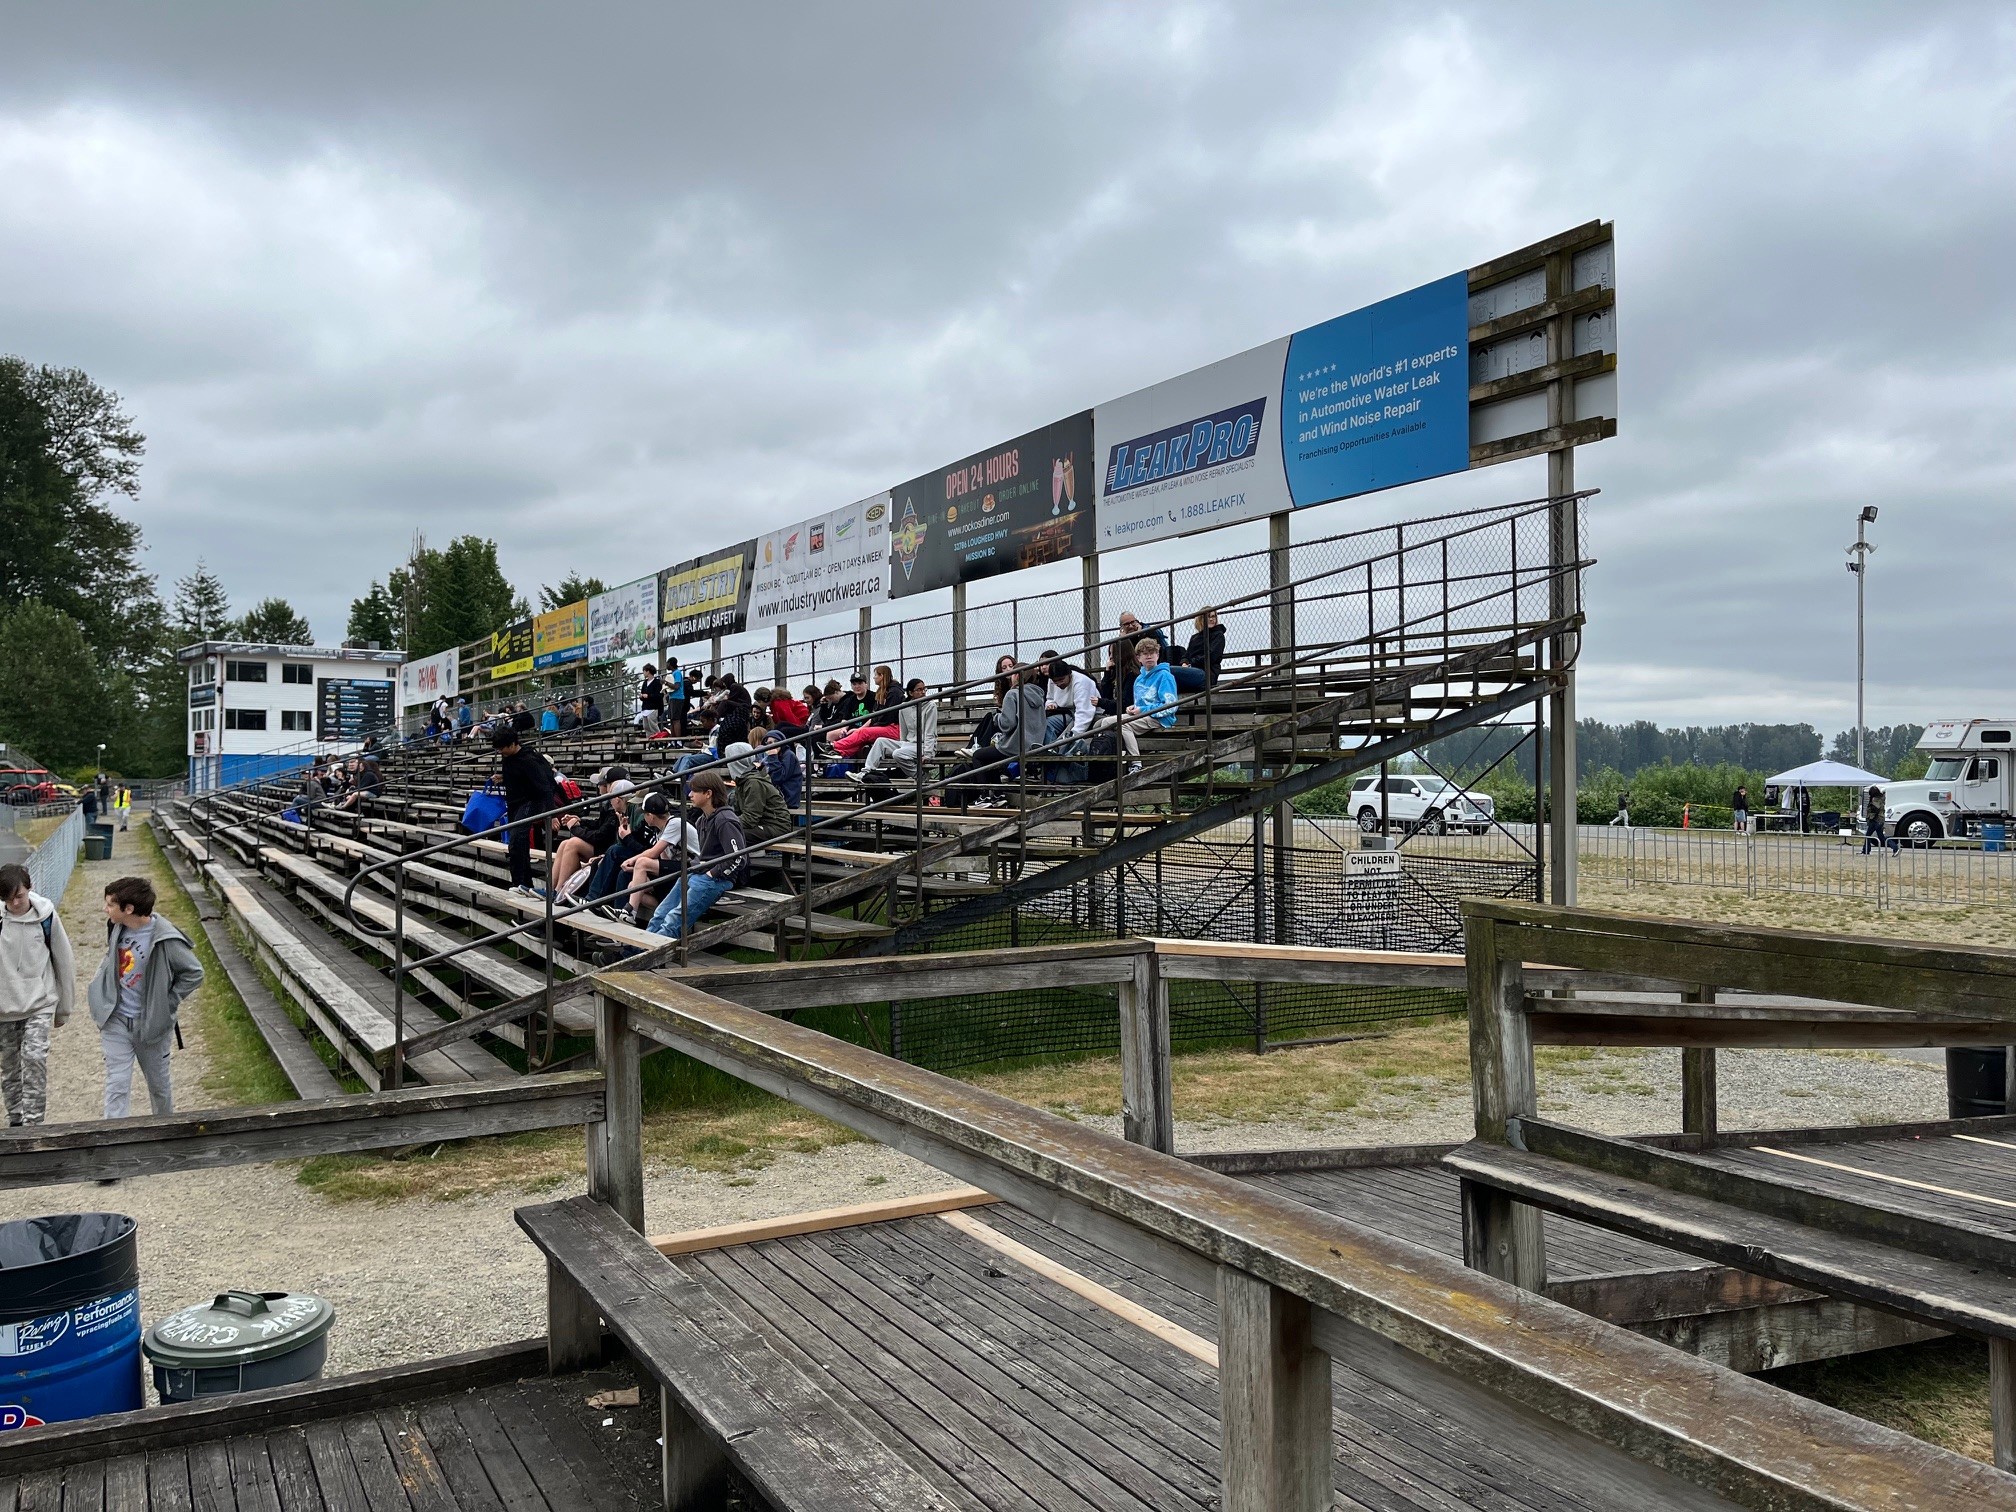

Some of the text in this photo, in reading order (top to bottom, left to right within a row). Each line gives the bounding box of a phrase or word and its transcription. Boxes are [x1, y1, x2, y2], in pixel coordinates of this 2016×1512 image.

[1299, 386, 1328, 403] We're
[1331, 379, 1348, 394] the
[1350, 365, 1392, 387] World's
[1395, 359, 1408, 375] #1
[1411, 345, 1458, 369] experts
[1299, 371, 1441, 423] in Automotive Water Leak
[1298, 420, 1427, 461] Franchising Opportunities Available
[1299, 398, 1421, 443] and Wind Noise Repair
[946, 449, 1019, 500] OPEN 24 HOURS
[866, 505, 885, 520] KEEN
[1115, 492, 1246, 535] leakpro.com 1.888.LEAKFIX
[827, 563, 841, 574] OPEN
[758, 576, 880, 618] www.industryworkwear.ca
[697, 616, 711, 630] AND
[712, 609, 737, 627] SAFETY
[1351, 856, 1394, 864] CHILDREN
[19, 1315, 65, 1345] Racing
[76, 1308, 132, 1337] vpracingfuels.com
